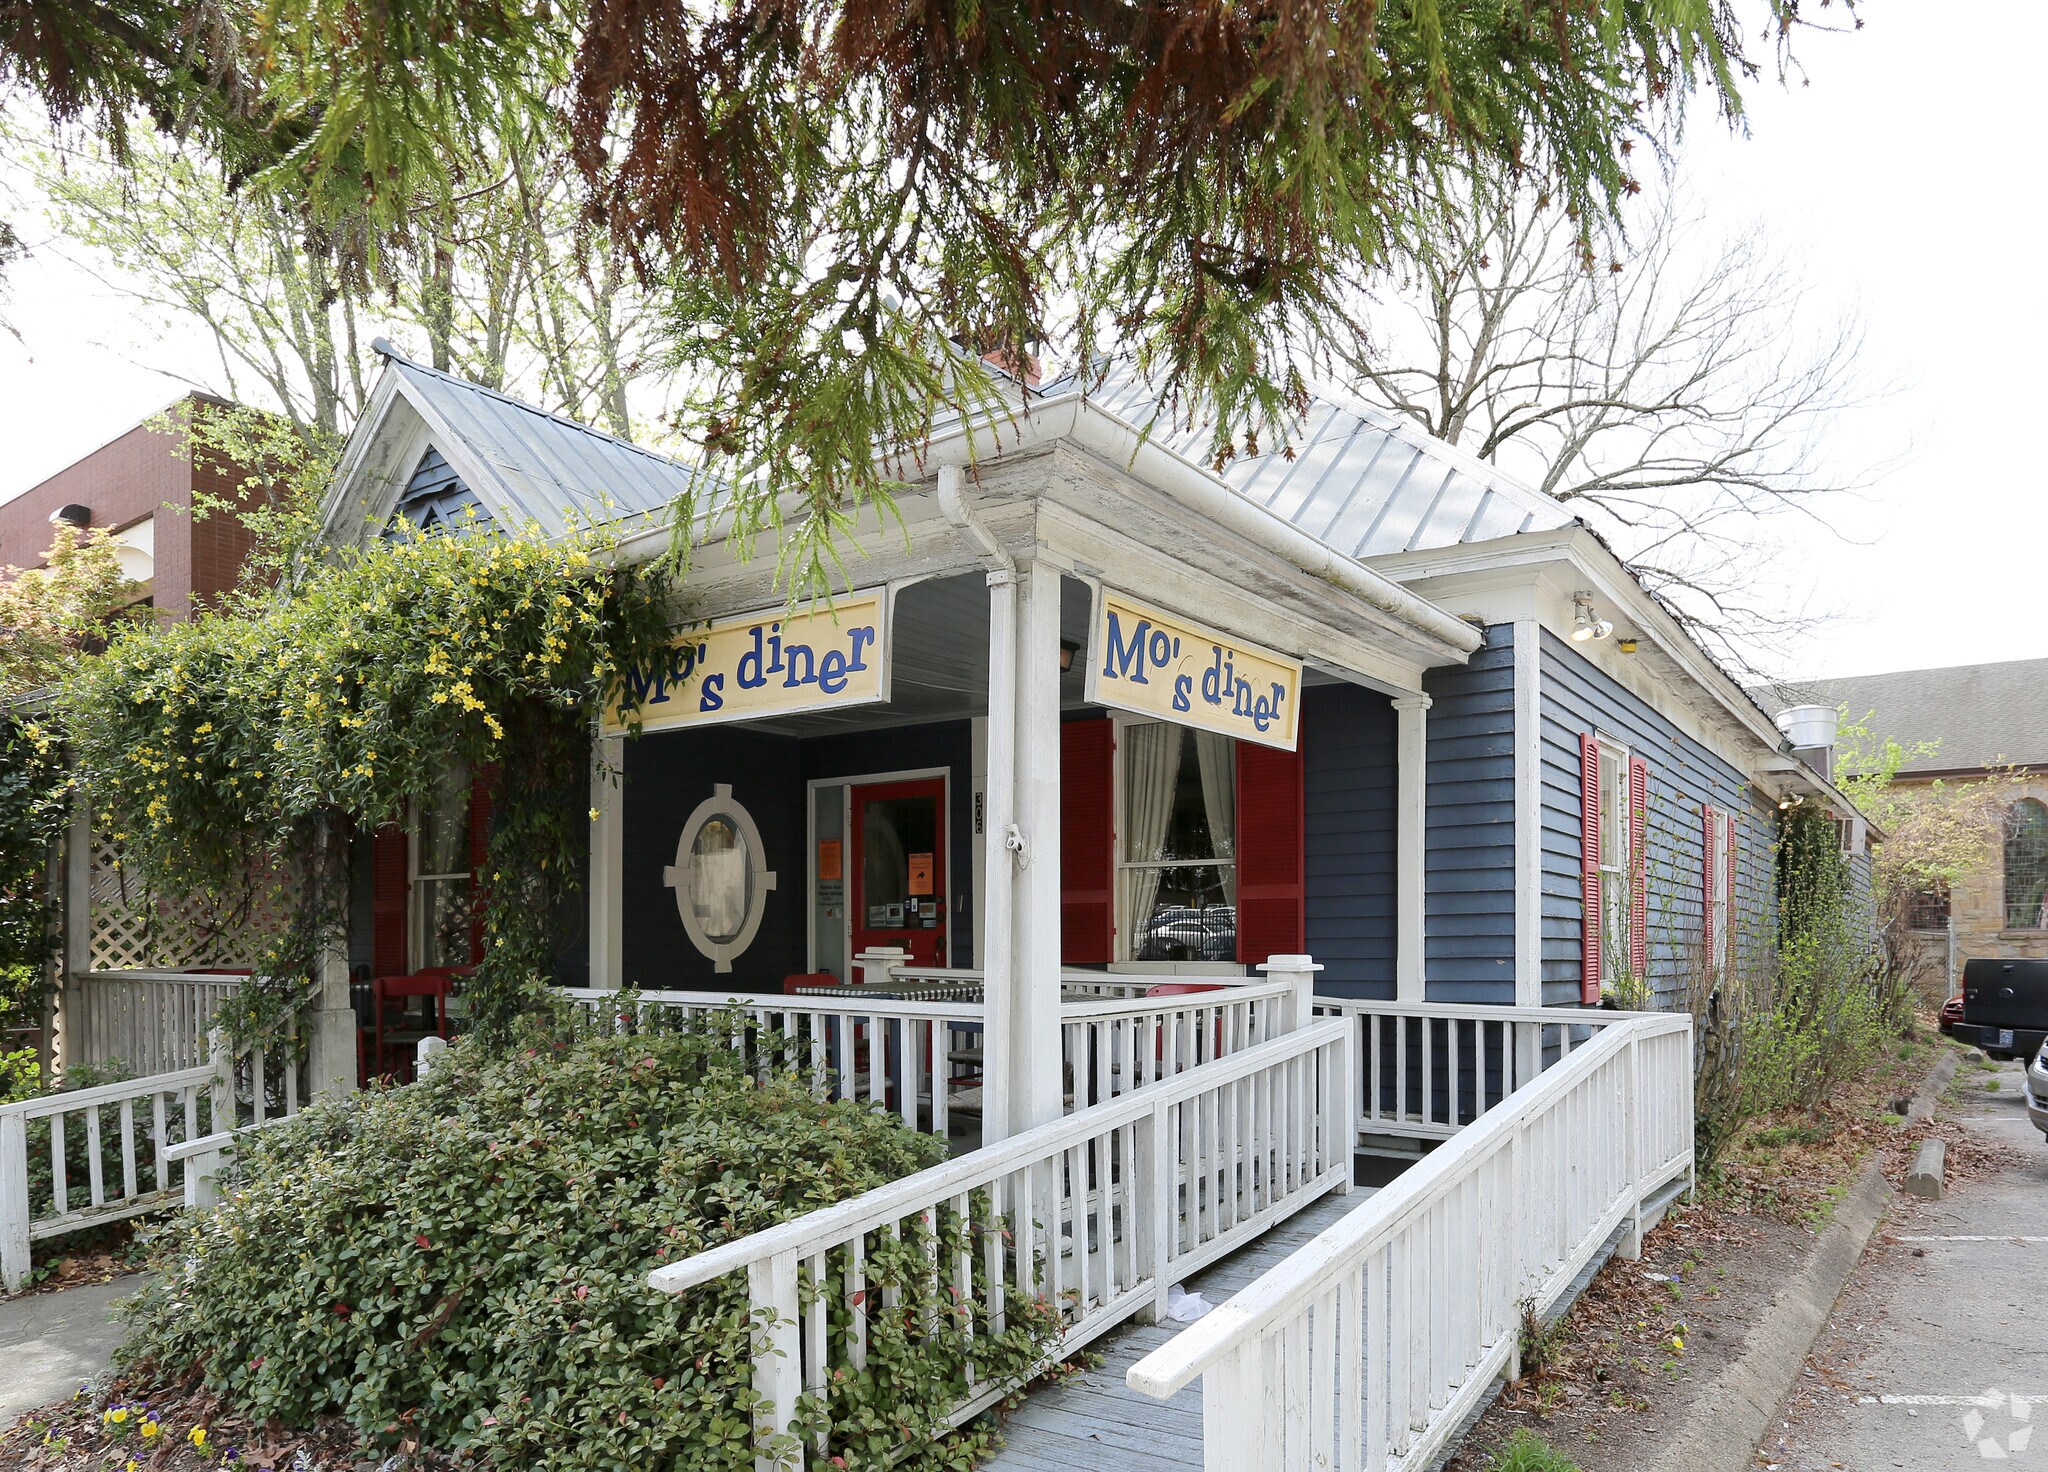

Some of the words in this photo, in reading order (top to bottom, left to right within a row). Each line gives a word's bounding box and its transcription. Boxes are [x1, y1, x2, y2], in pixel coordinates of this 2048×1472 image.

[619, 643, 725, 713] Mo's
[736, 622, 876, 695] diner
[1102, 609, 1193, 713] Mo's
[1201, 645, 1286, 733] diner
